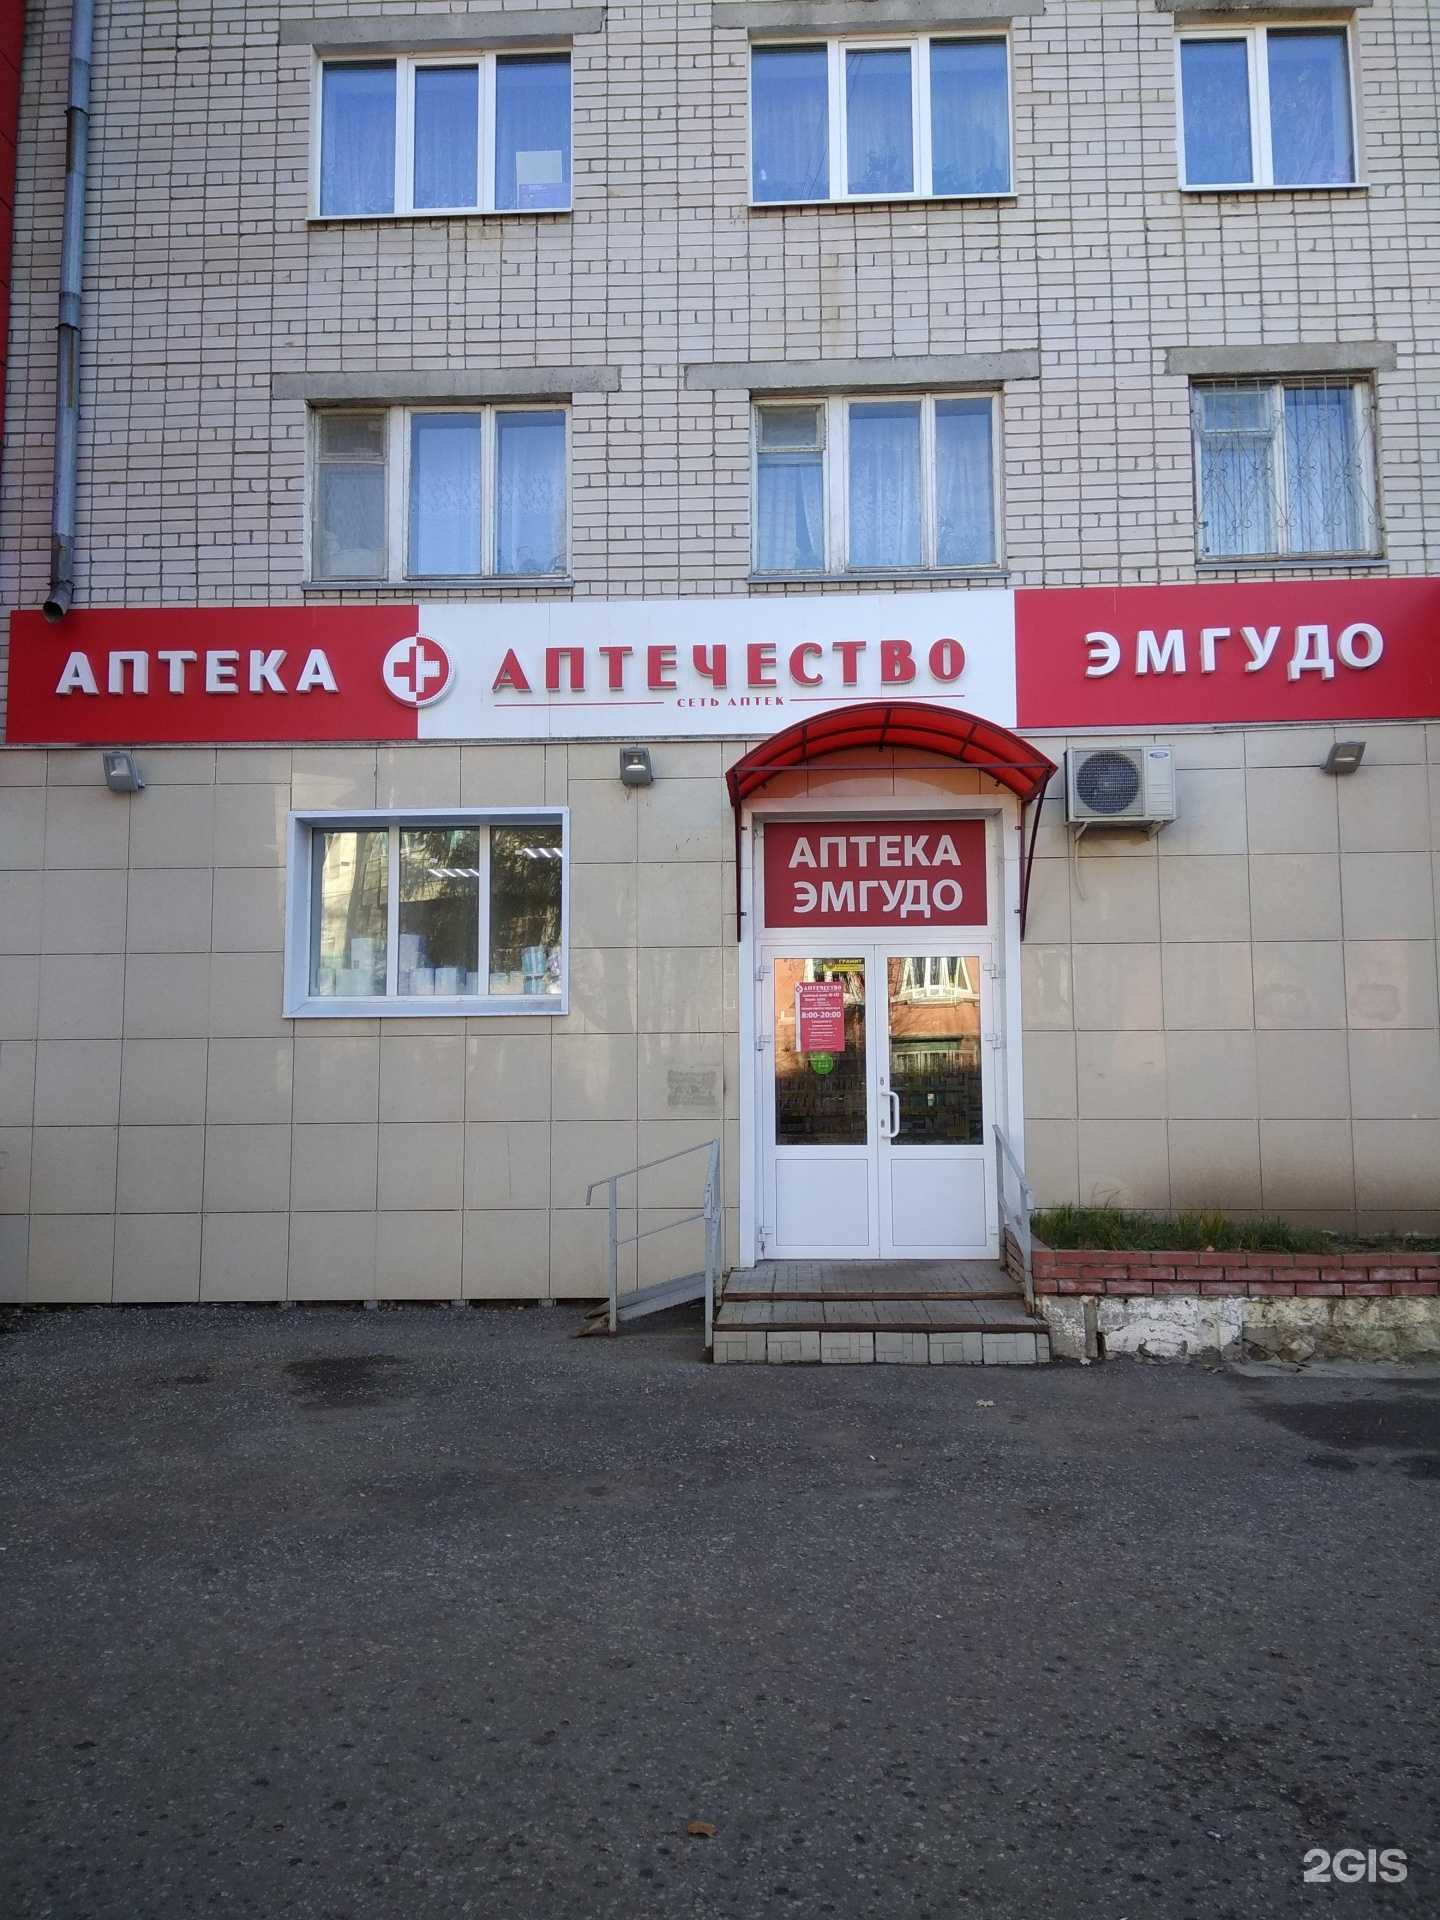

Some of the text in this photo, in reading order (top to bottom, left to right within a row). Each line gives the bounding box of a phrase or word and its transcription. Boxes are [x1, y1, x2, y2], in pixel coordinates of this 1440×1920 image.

[55, 648, 339, 694] АПТЕКА
[491, 638, 966, 692] АПТЕЧЕСТВО
[1085, 623, 1383, 680] ЭМГУДО
[677, 696, 785, 708] СЕТЬ АПТЕК
[788, 834, 961, 868] АПТЕКА
[793, 879, 963, 918] ЭМГУДО
